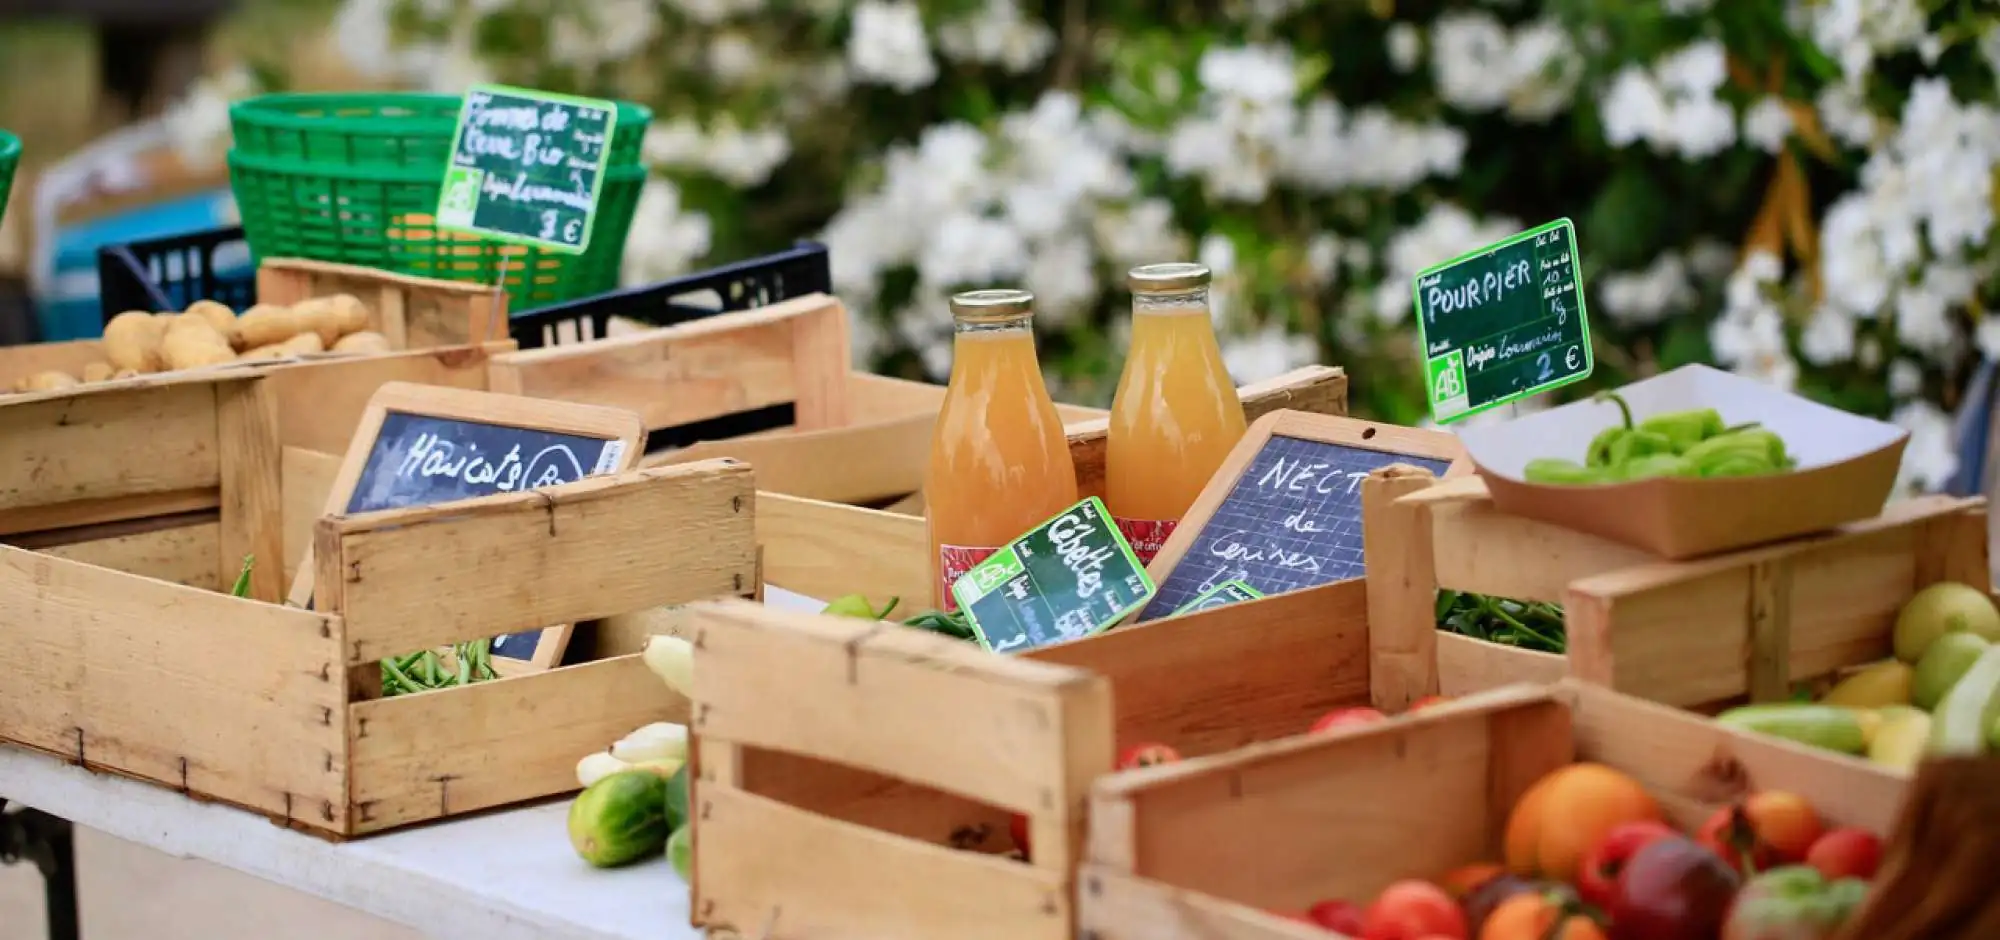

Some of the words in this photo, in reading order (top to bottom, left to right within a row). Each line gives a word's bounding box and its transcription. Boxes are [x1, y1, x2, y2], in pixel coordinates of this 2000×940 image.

[563, 219, 582, 242] €
[1536, 353, 1556, 381] 2
[1564, 345, 1581, 371] €
[1434, 367, 1461, 402] AB
[1257, 456, 1371, 495] NECT
[1284, 509, 1323, 533] de
